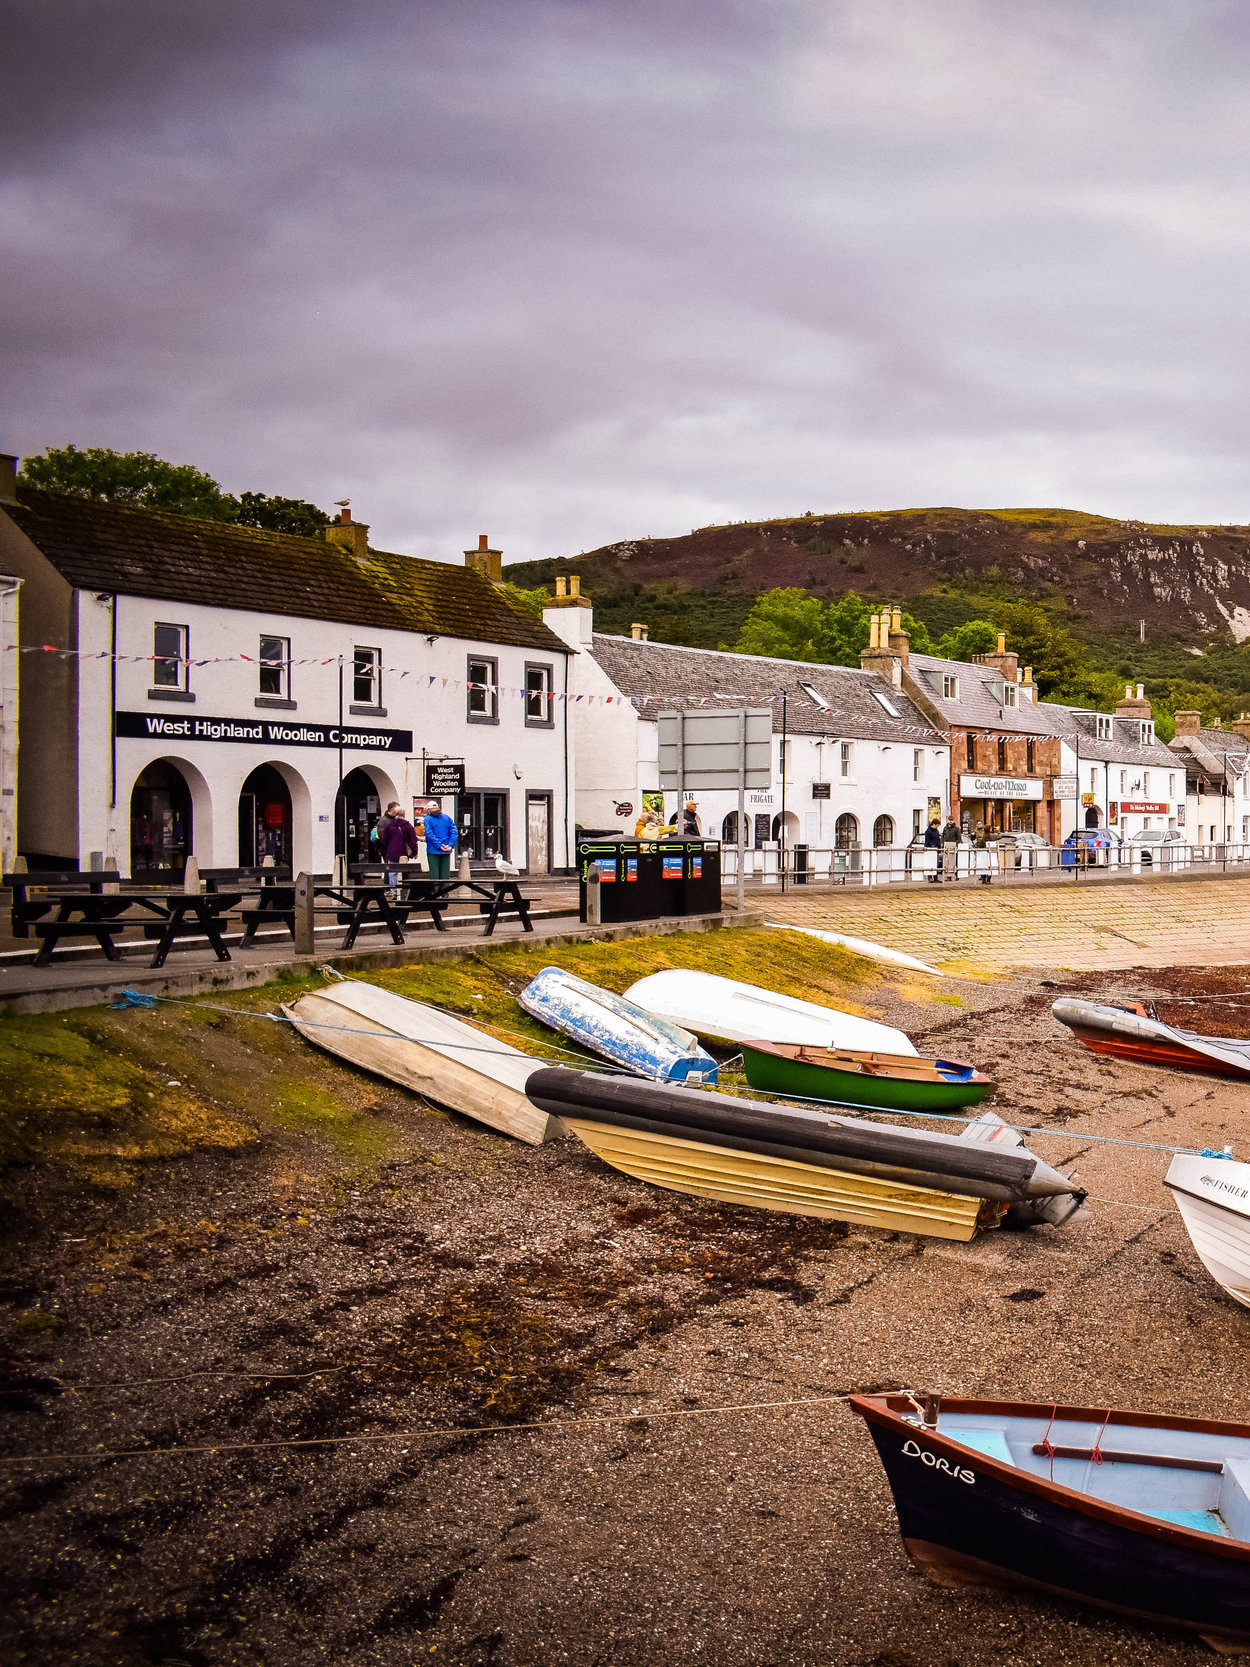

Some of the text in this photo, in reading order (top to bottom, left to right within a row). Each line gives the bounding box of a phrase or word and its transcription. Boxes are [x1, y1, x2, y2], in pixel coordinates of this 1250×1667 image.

[145, 718, 191, 735] West
[194, 721, 263, 739] Highland
[267, 725, 325, 743] Woollen
[431, 773, 460, 781] Highland
[682, 792, 694, 801] AR
[750, 794, 774, 803] FRIGATE
[1213, 1179, 1249, 1199] FISHER
[901, 1440, 976, 1485] DORIS
